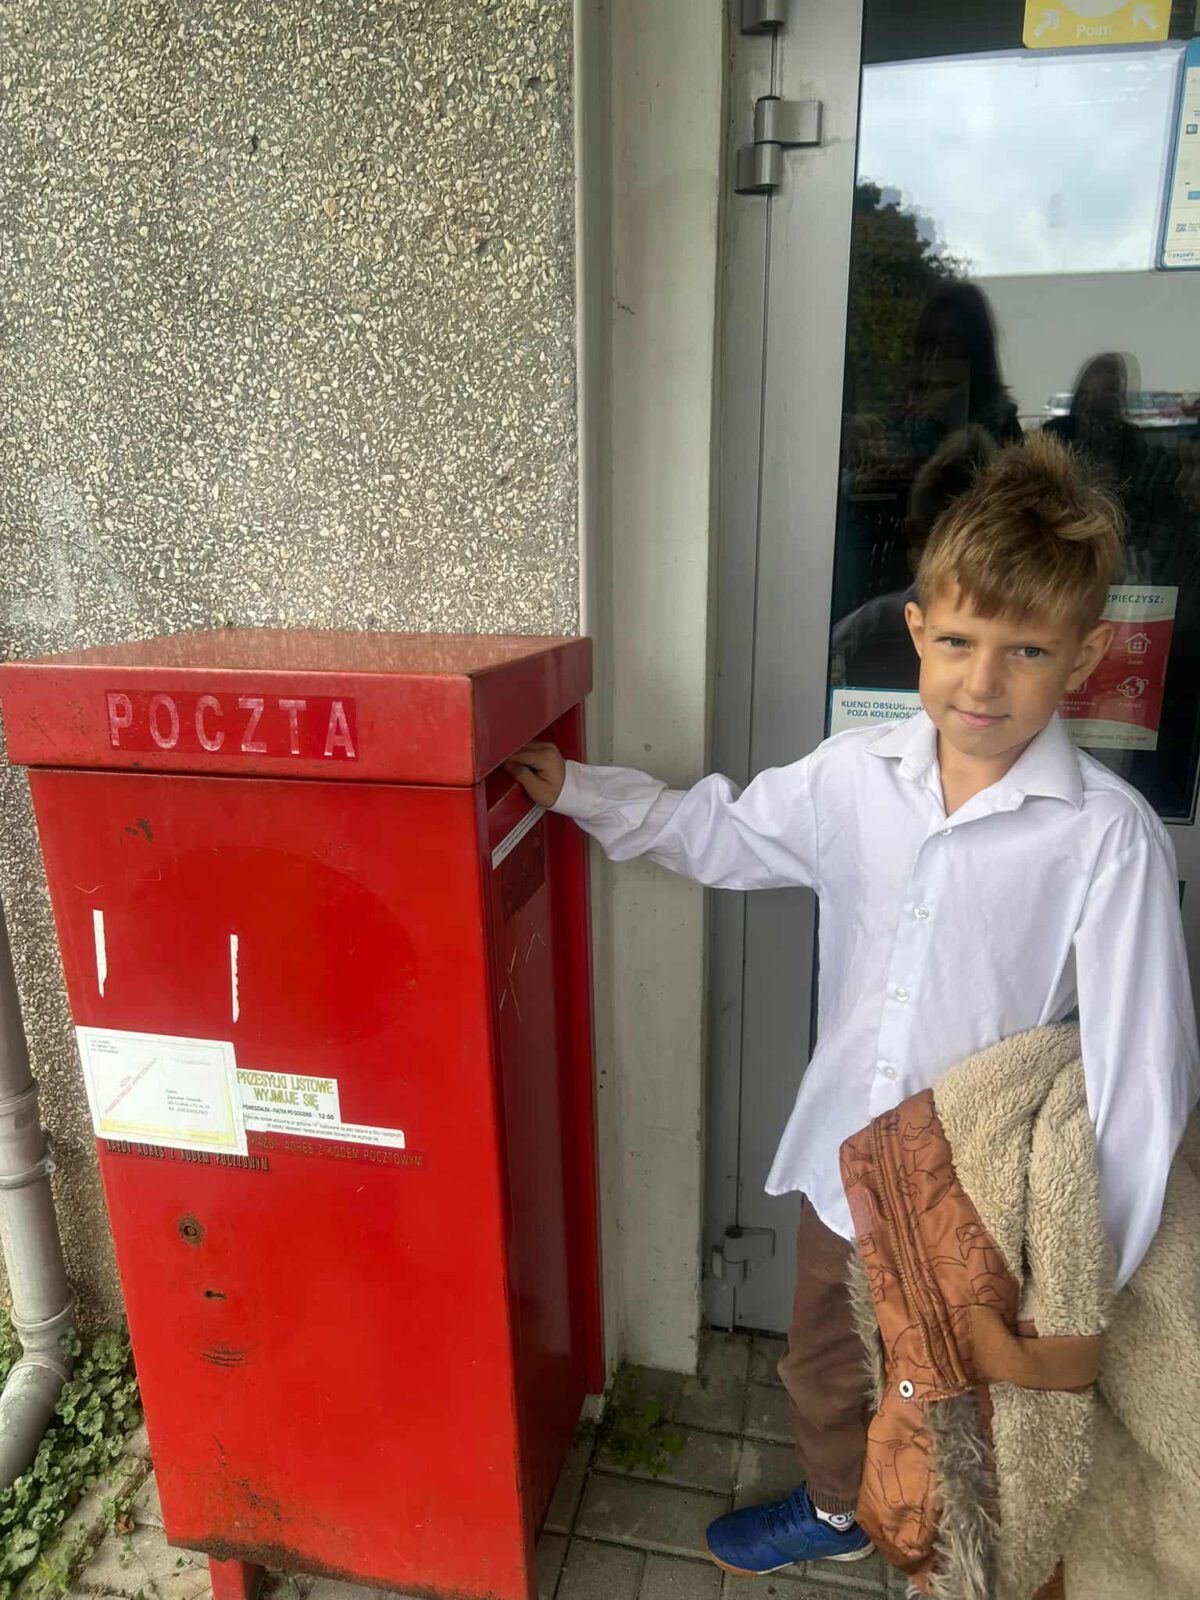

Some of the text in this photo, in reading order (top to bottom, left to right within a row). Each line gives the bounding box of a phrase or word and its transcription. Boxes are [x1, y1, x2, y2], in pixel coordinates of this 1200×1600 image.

[1076, 24, 1113, 39] Point
[841, 700, 871, 708] KLIENCI
[847, 709, 868, 717] POZA
[106, 693, 356, 758] POCZTA
[237, 1070, 334, 1094] PRZESYŁKI LISTOWE
[254, 1087, 320, 1111] WYJMUJE SIĘ
